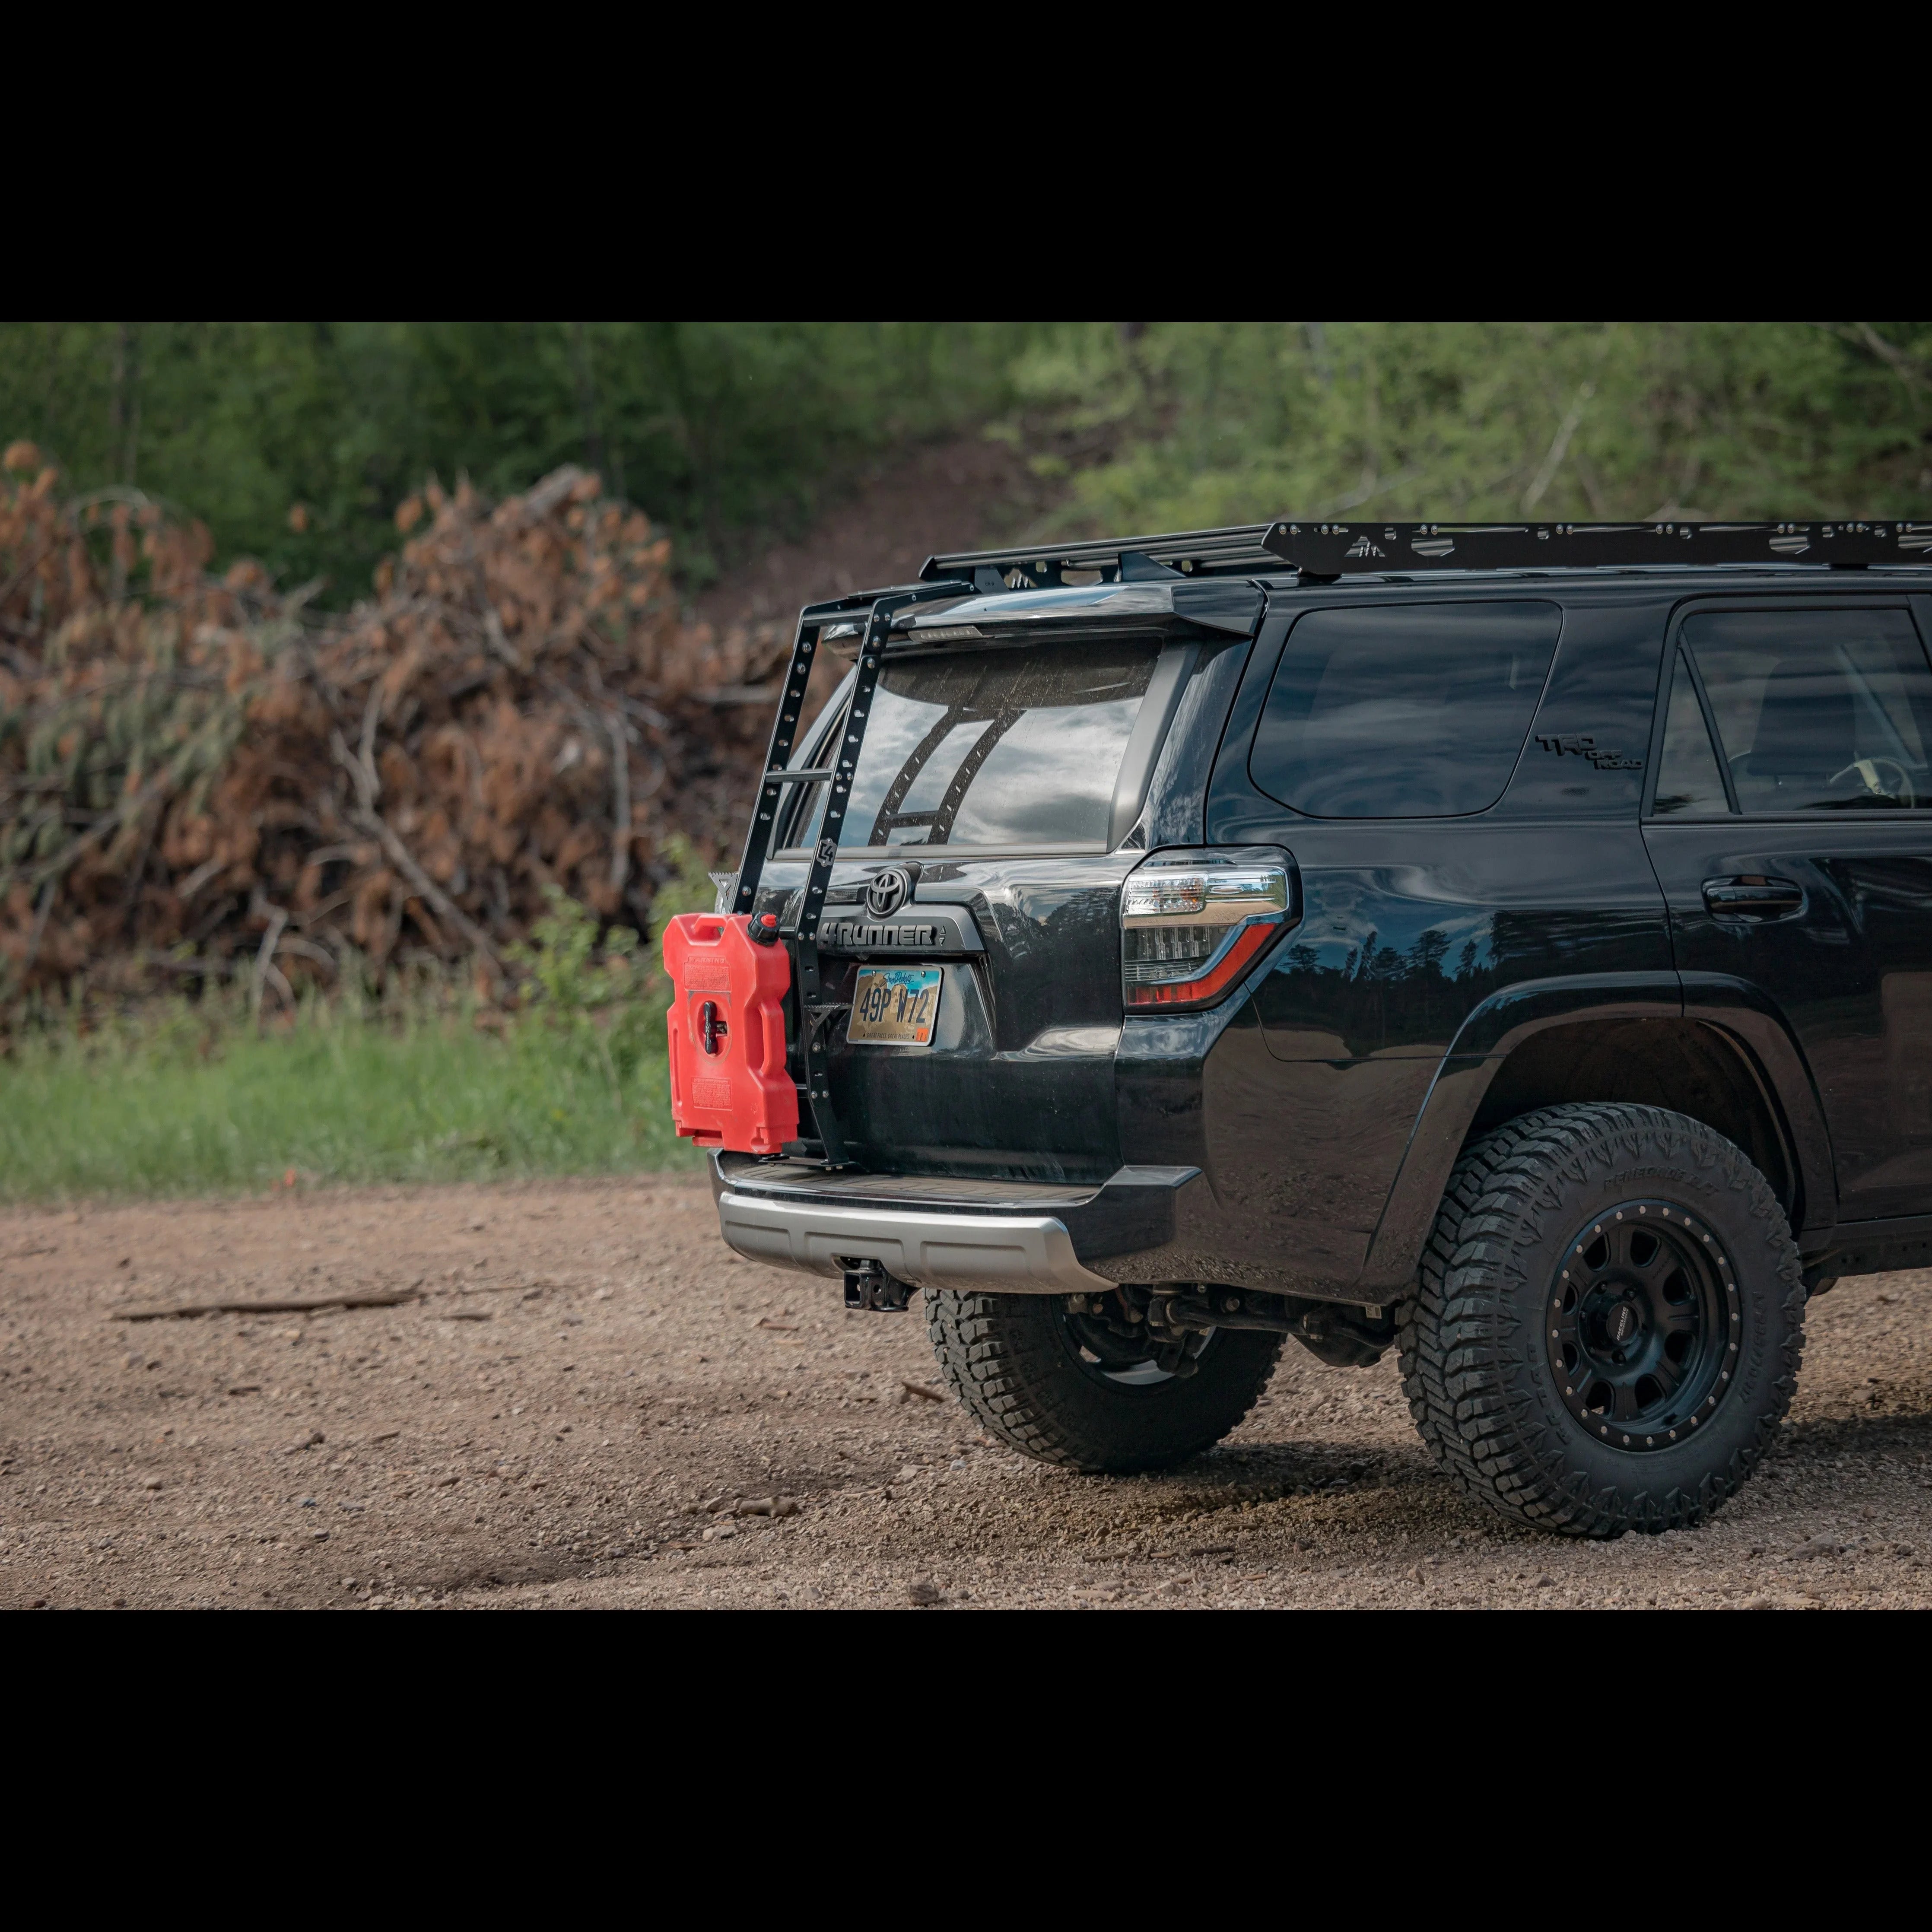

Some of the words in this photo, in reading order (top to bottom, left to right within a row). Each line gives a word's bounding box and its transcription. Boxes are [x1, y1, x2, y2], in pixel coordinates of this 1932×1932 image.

[1535, 734, 1597, 756] TRD
[1585, 750, 1623, 760] OFF
[1594, 759, 1643, 770] ROAD
[821, 923, 934, 946] 4RUNNER
[859, 988, 892, 1022] 49P
[896, 988, 929, 1023] W72
